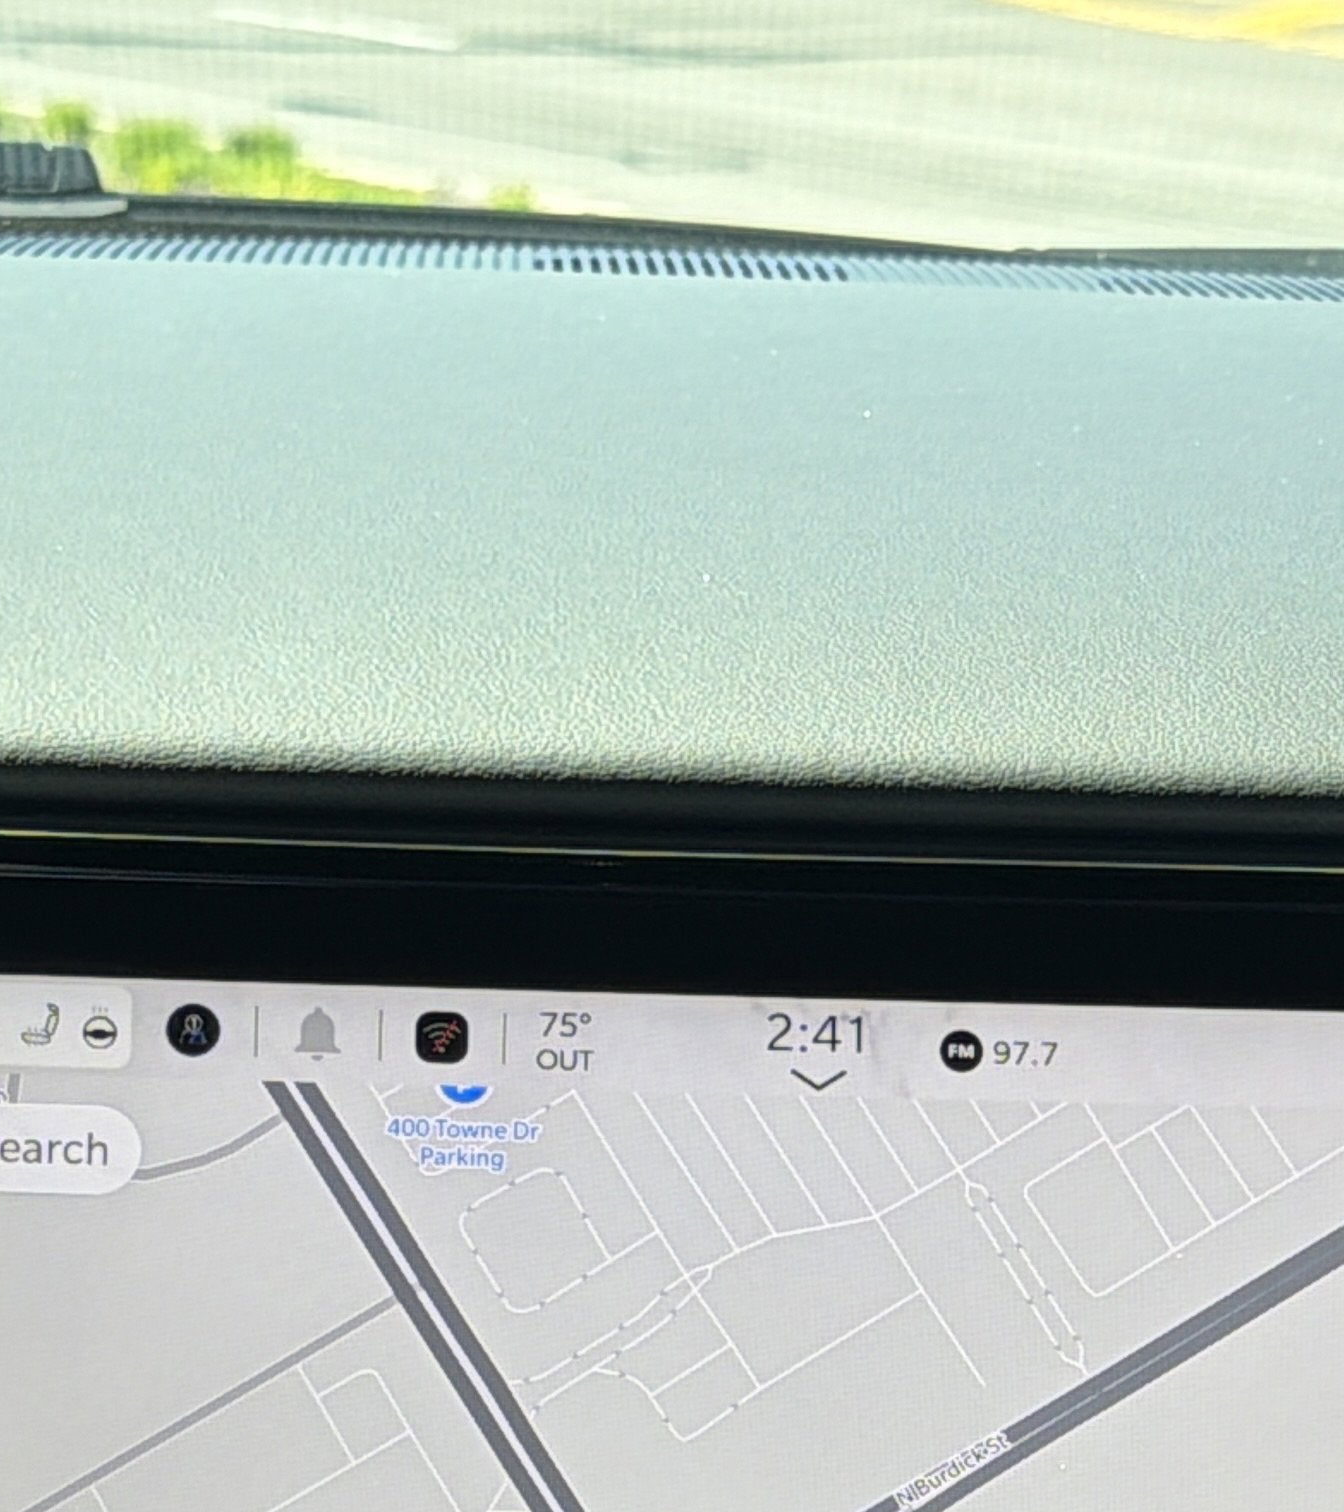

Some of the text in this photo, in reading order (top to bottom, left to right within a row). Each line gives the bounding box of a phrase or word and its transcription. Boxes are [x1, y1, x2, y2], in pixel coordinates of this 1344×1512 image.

[767, 1012, 864, 1054] 2:41
[535, 1048, 595, 1071] OUT
[947, 1040, 1058, 1066] FM 97.7
[387, 1118, 540, 1141] 400 Towne Dr
[420, 1146, 505, 1172] Parking
[913, 1448, 987, 1498] Burdick
[986, 1435, 1008, 1455] St
